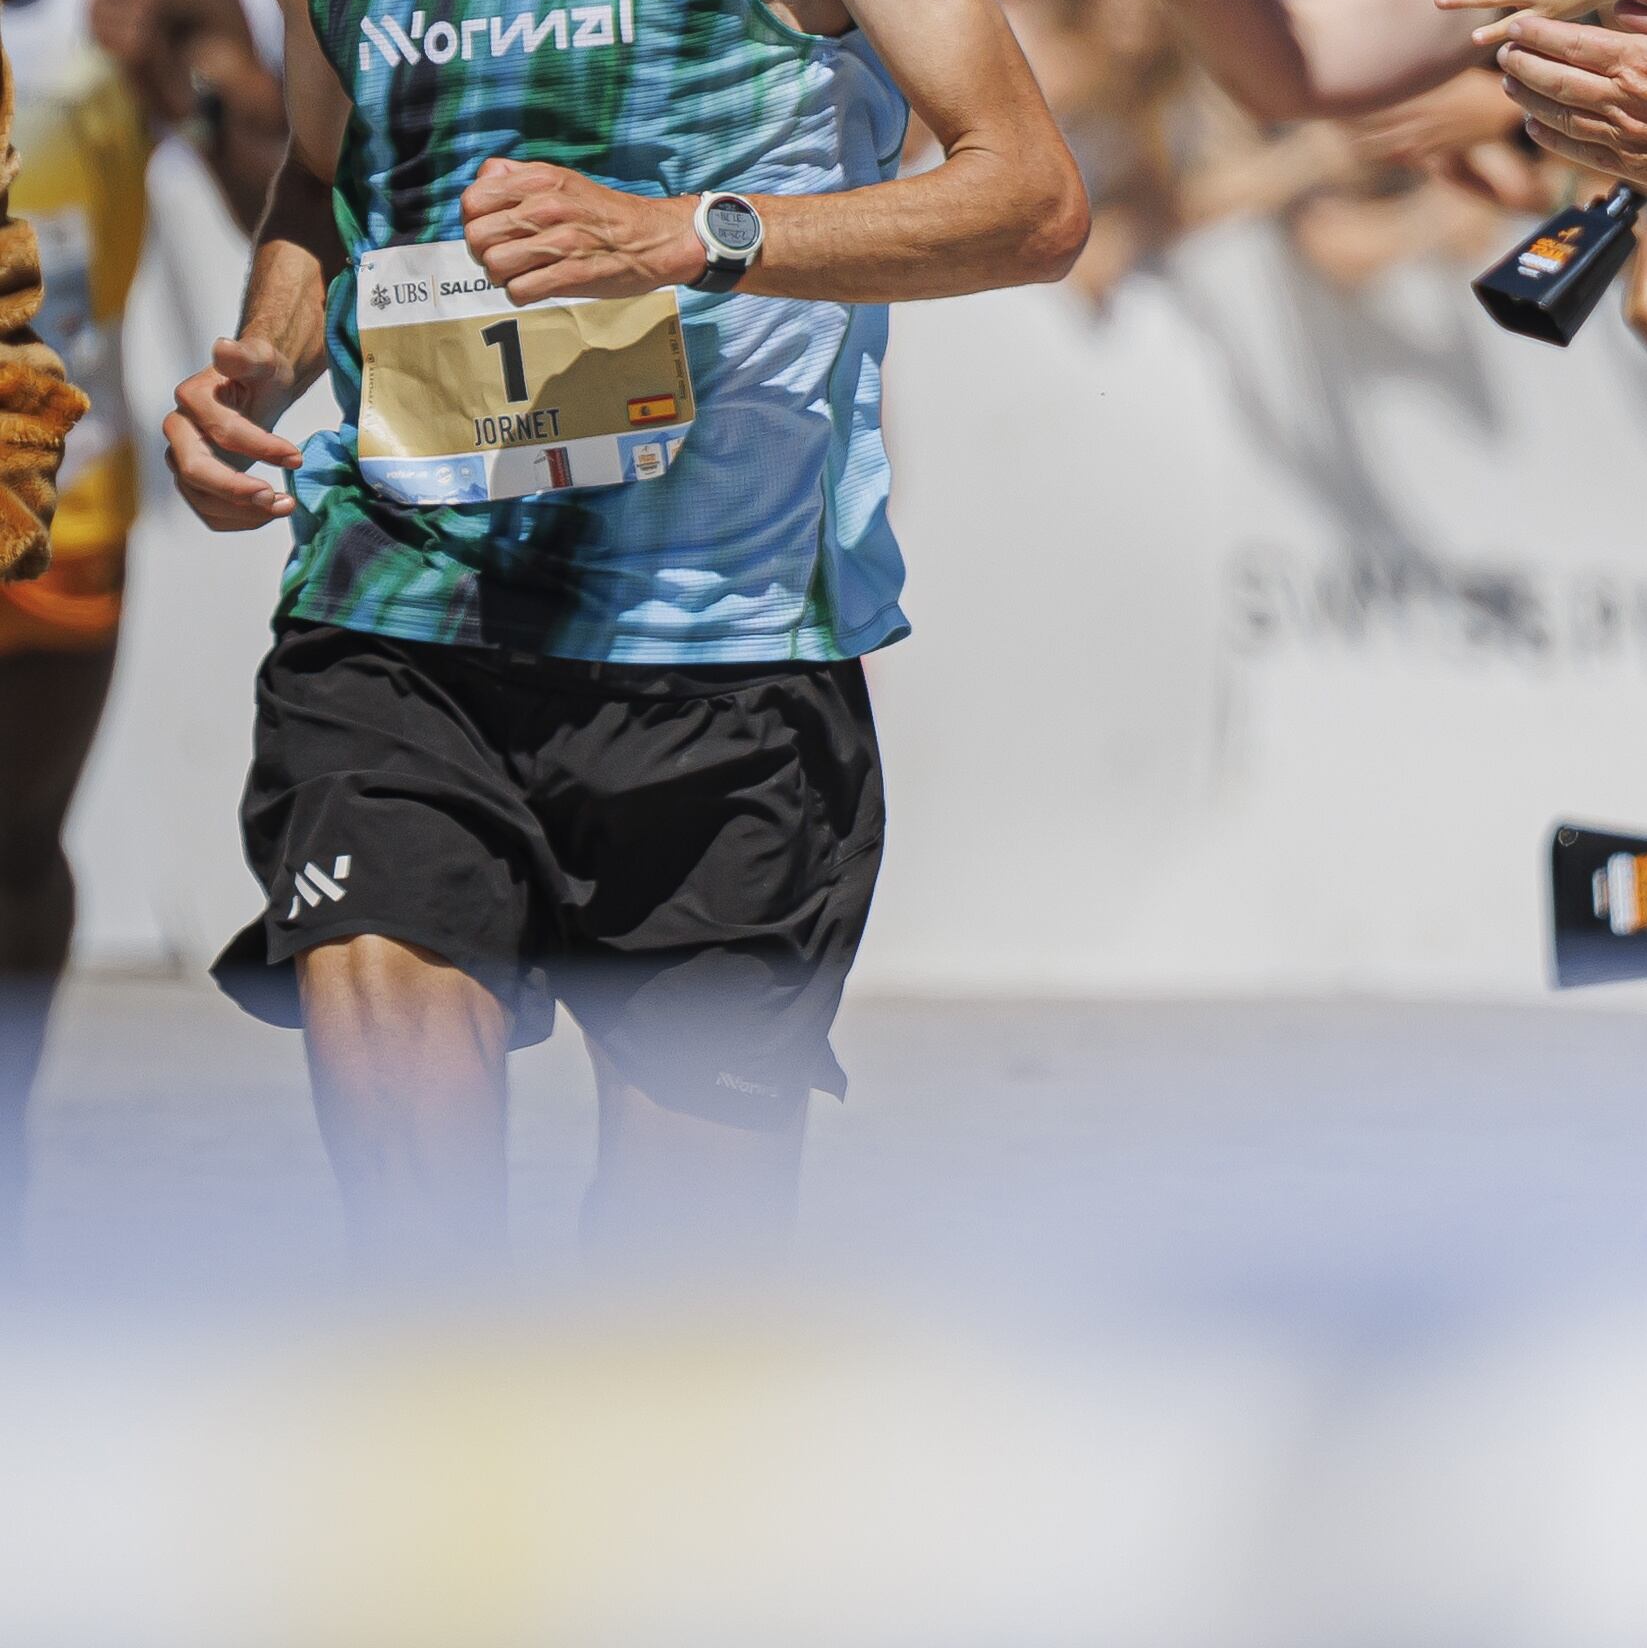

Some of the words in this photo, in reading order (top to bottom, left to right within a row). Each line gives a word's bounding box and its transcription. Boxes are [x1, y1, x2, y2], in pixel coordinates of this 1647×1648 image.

[394, 282, 428, 305] UBS
[479, 318, 529, 404] 1
[474, 408, 560, 448] JORNET
